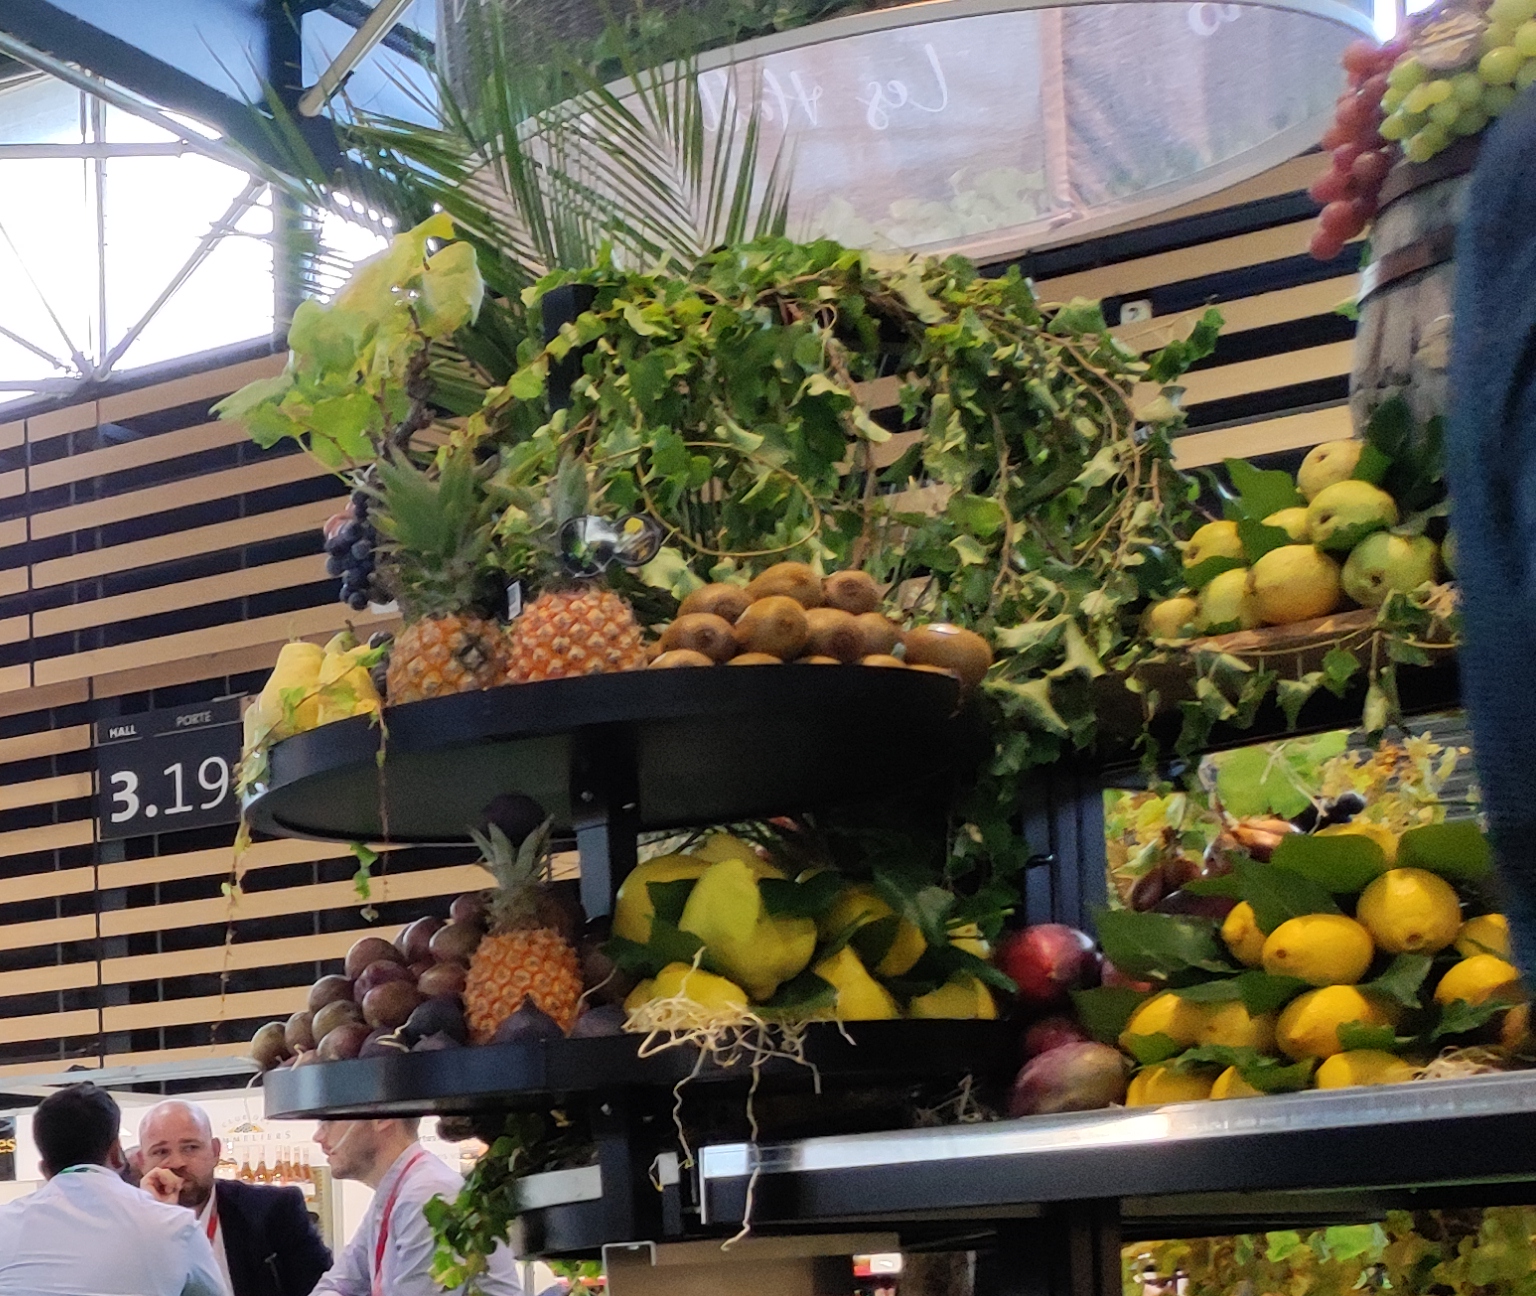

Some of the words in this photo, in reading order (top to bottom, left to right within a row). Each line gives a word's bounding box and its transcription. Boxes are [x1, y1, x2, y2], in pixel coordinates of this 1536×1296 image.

[176, 710, 212, 727] PORTE
[109, 725, 137, 738] HALL
[110, 756, 229, 823] 3.19
